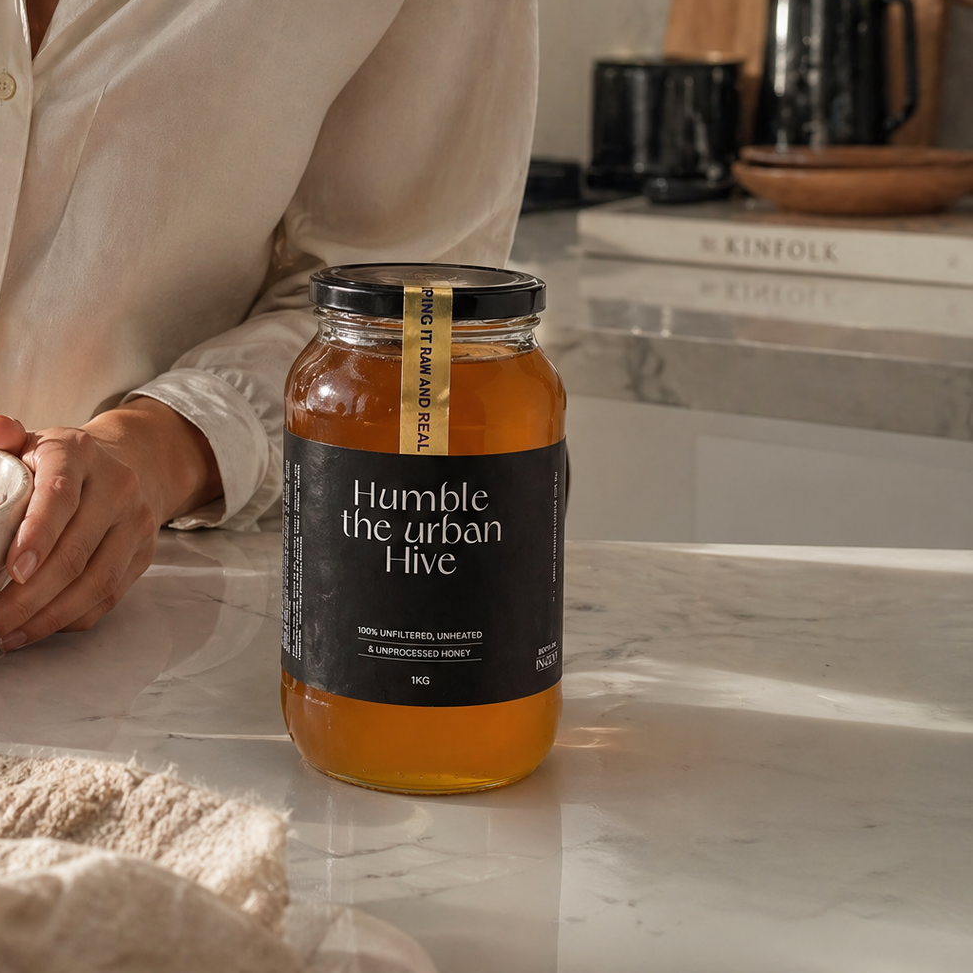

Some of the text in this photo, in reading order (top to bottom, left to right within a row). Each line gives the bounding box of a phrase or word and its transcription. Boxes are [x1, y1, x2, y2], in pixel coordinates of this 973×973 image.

[724, 234, 839, 265] KINFOLK
[417, 286, 434, 452] PING IT RAW AND REAL
[354, 479, 489, 512] Humble
[340, 507, 502, 545] the urban
[385, 545, 457, 575] Hive
[357, 626, 483, 641] 100% UNFILTERED, UNHEATED
[367, 644, 471, 658] & UNPROCESSED HONEY
[410, 675, 431, 686] 1KG
